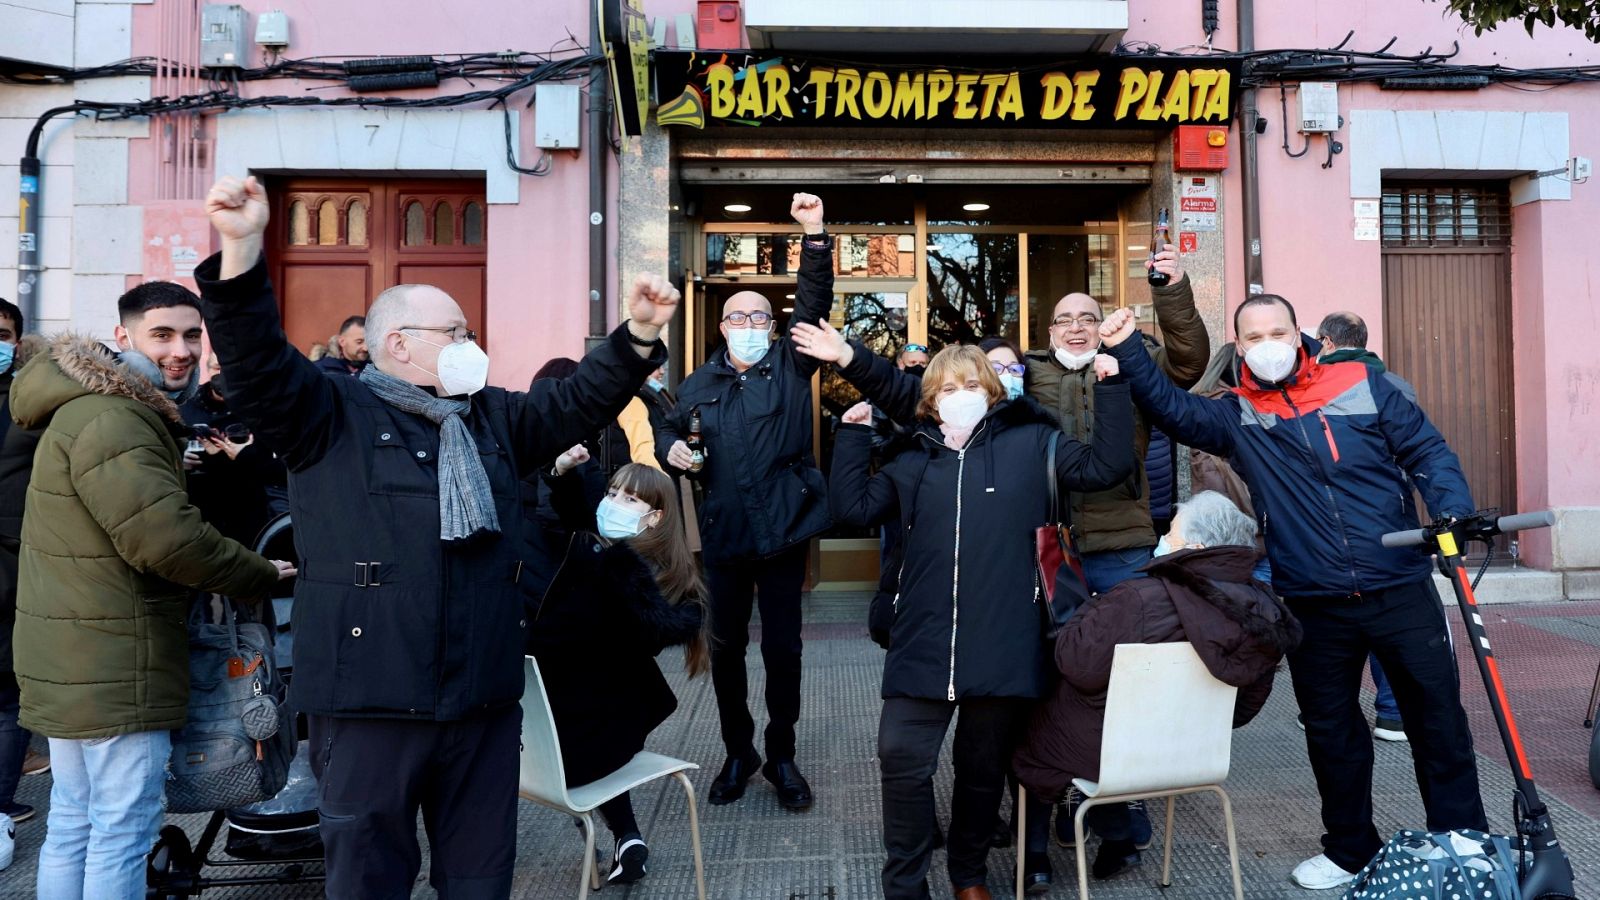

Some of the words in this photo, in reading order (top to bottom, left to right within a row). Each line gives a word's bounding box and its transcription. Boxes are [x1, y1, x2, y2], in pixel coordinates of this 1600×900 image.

[706, 65, 794, 119] BAR
[809, 68, 1025, 121] TROMPETA
[1040, 69, 1100, 121] DE
[1113, 67, 1230, 122] PLATA
[364, 124, 380, 146] 7
